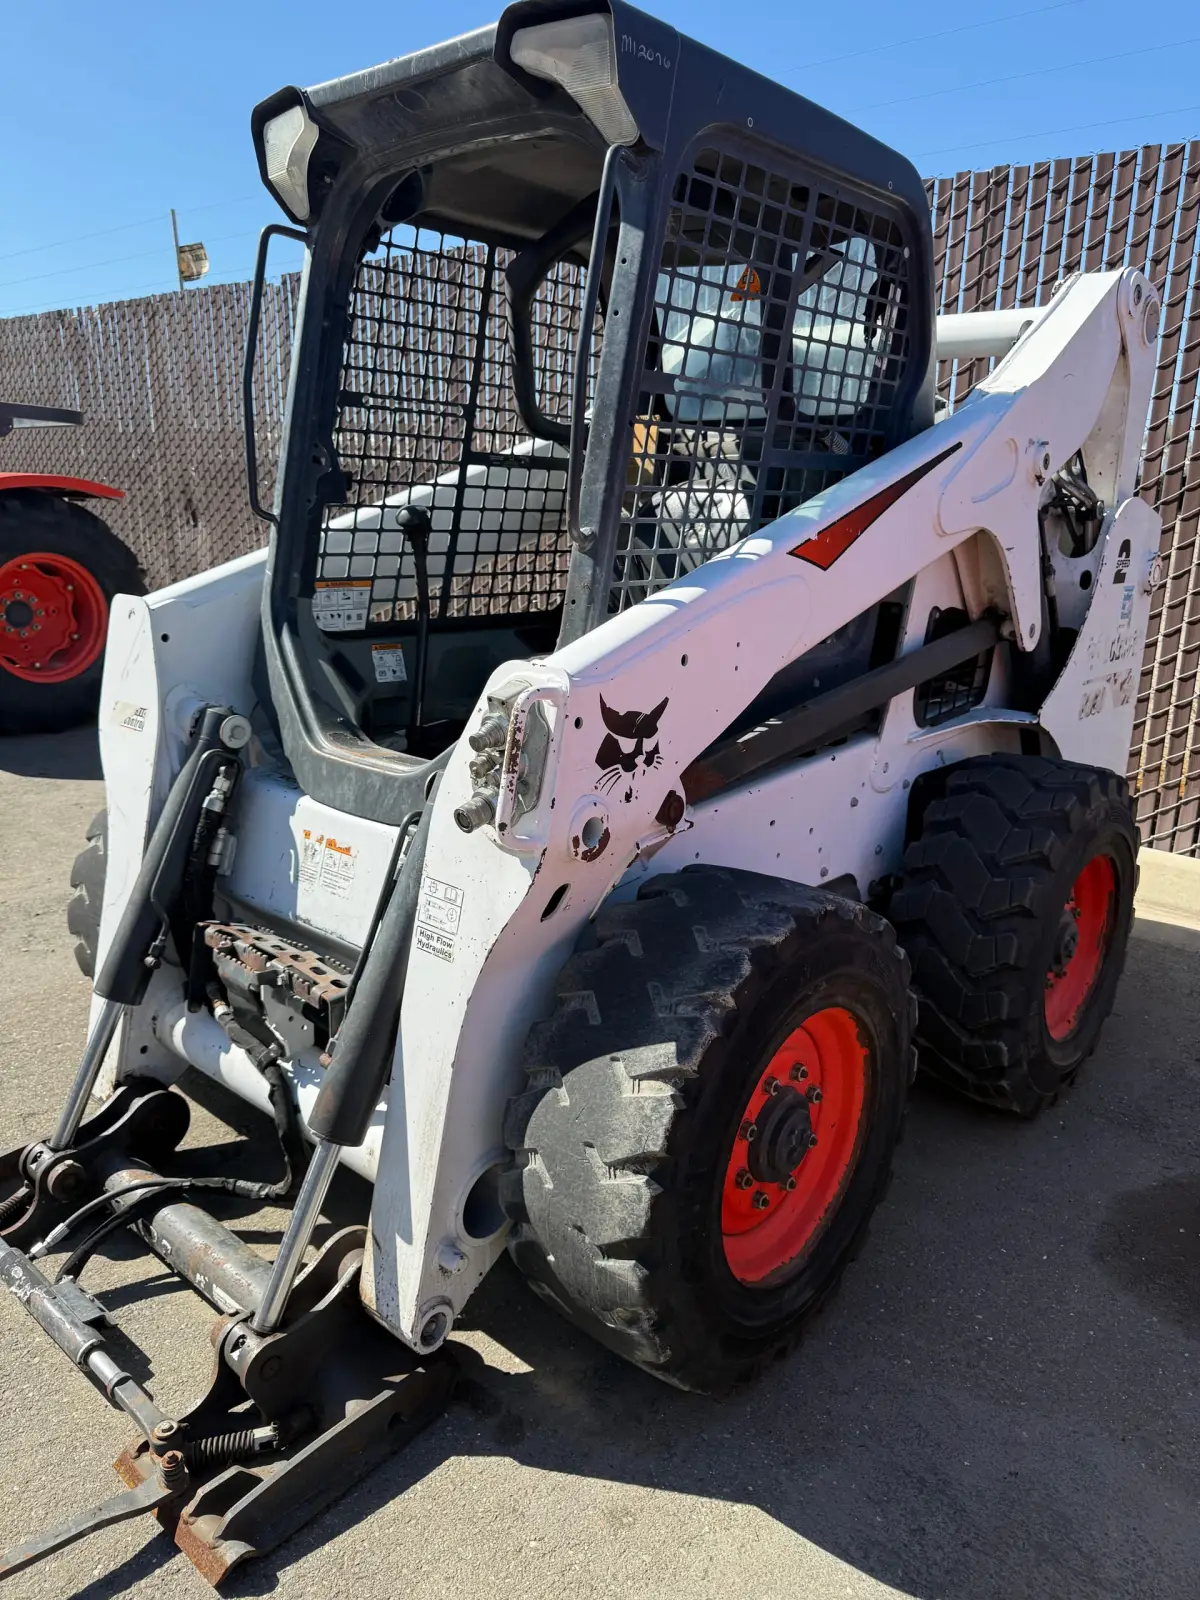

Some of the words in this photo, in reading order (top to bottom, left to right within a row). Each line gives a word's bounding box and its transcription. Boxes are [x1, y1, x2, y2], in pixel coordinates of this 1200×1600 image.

[1115, 559, 1131, 569] SPEED
[416, 938, 452, 959] Hydraulics
[419, 929, 435, 941] High
[436, 936, 453, 949] Flow
